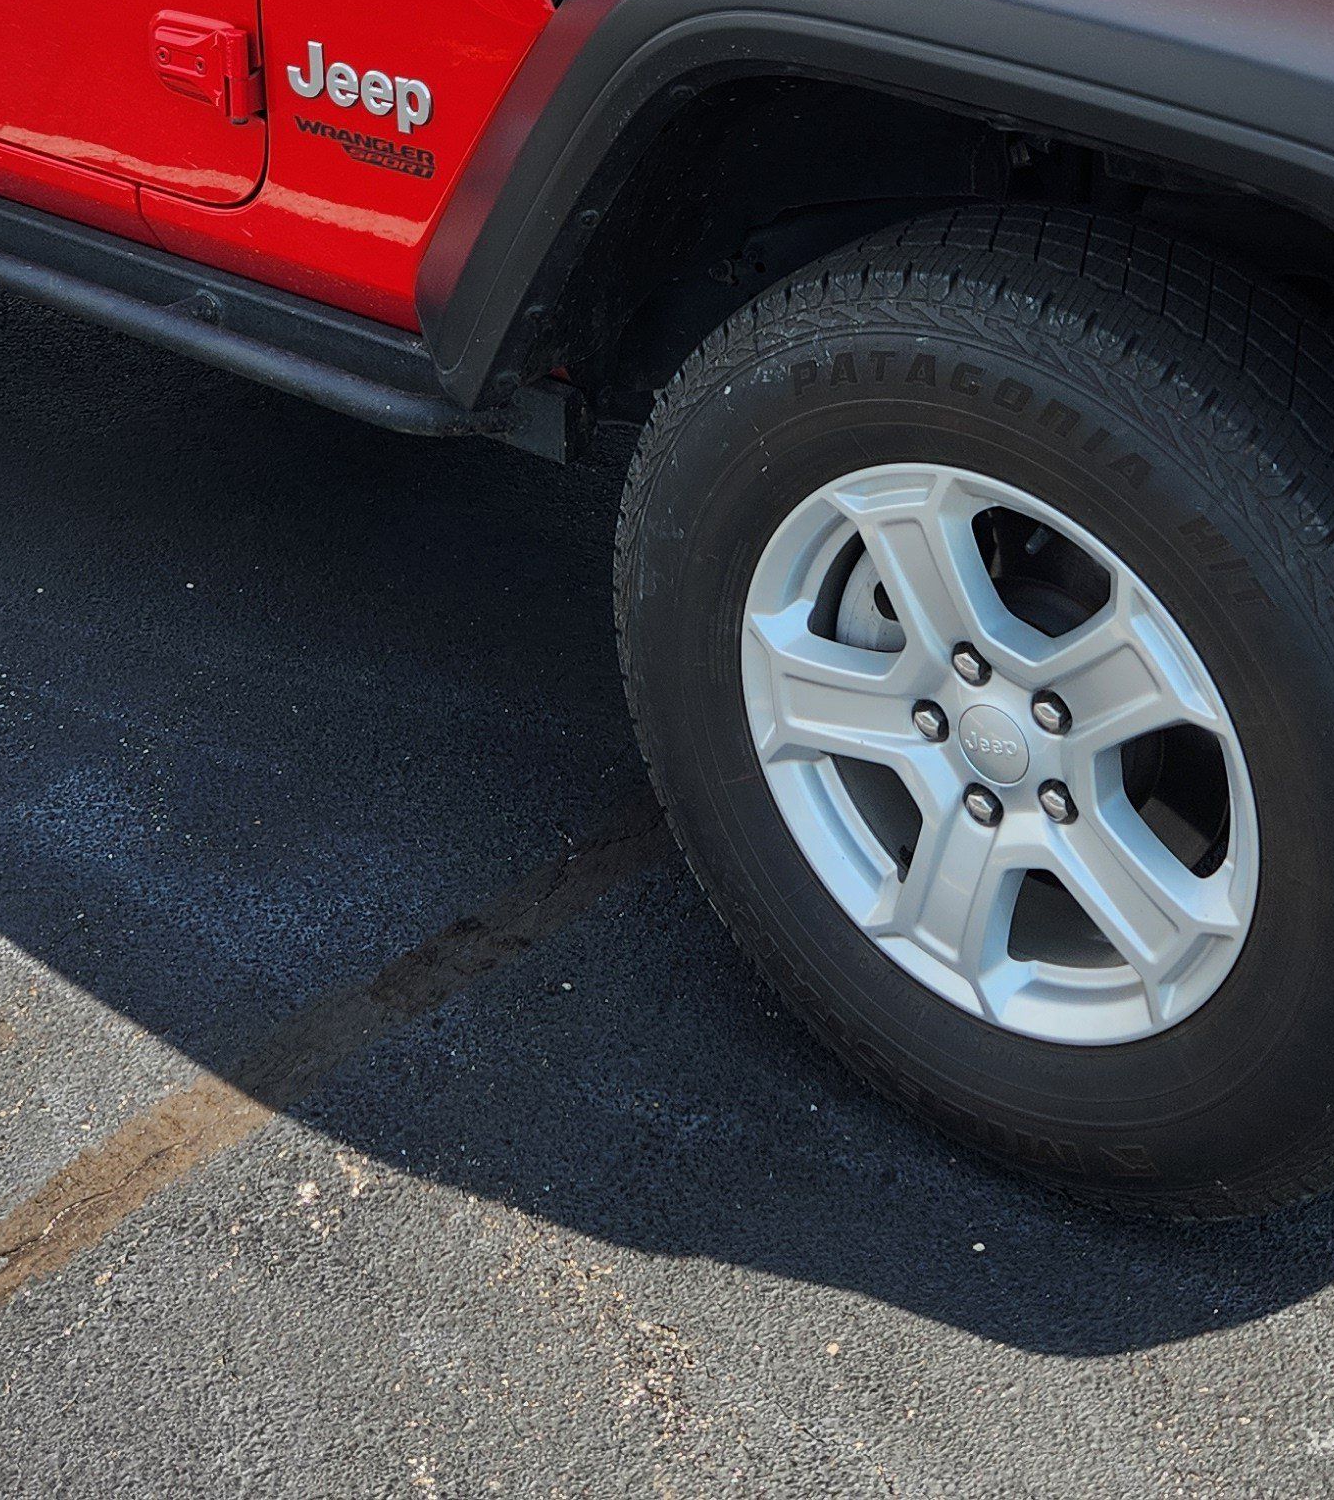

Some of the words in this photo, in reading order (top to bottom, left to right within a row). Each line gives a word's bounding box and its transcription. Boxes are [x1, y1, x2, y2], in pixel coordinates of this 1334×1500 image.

[287, 40, 433, 134] Jeep
[294, 116, 434, 165] WRANGLER
[345, 146, 434, 178] SPORT
[789, 350, 1157, 491] PATAGONIA
[964, 731, 1018, 758] Jeep
